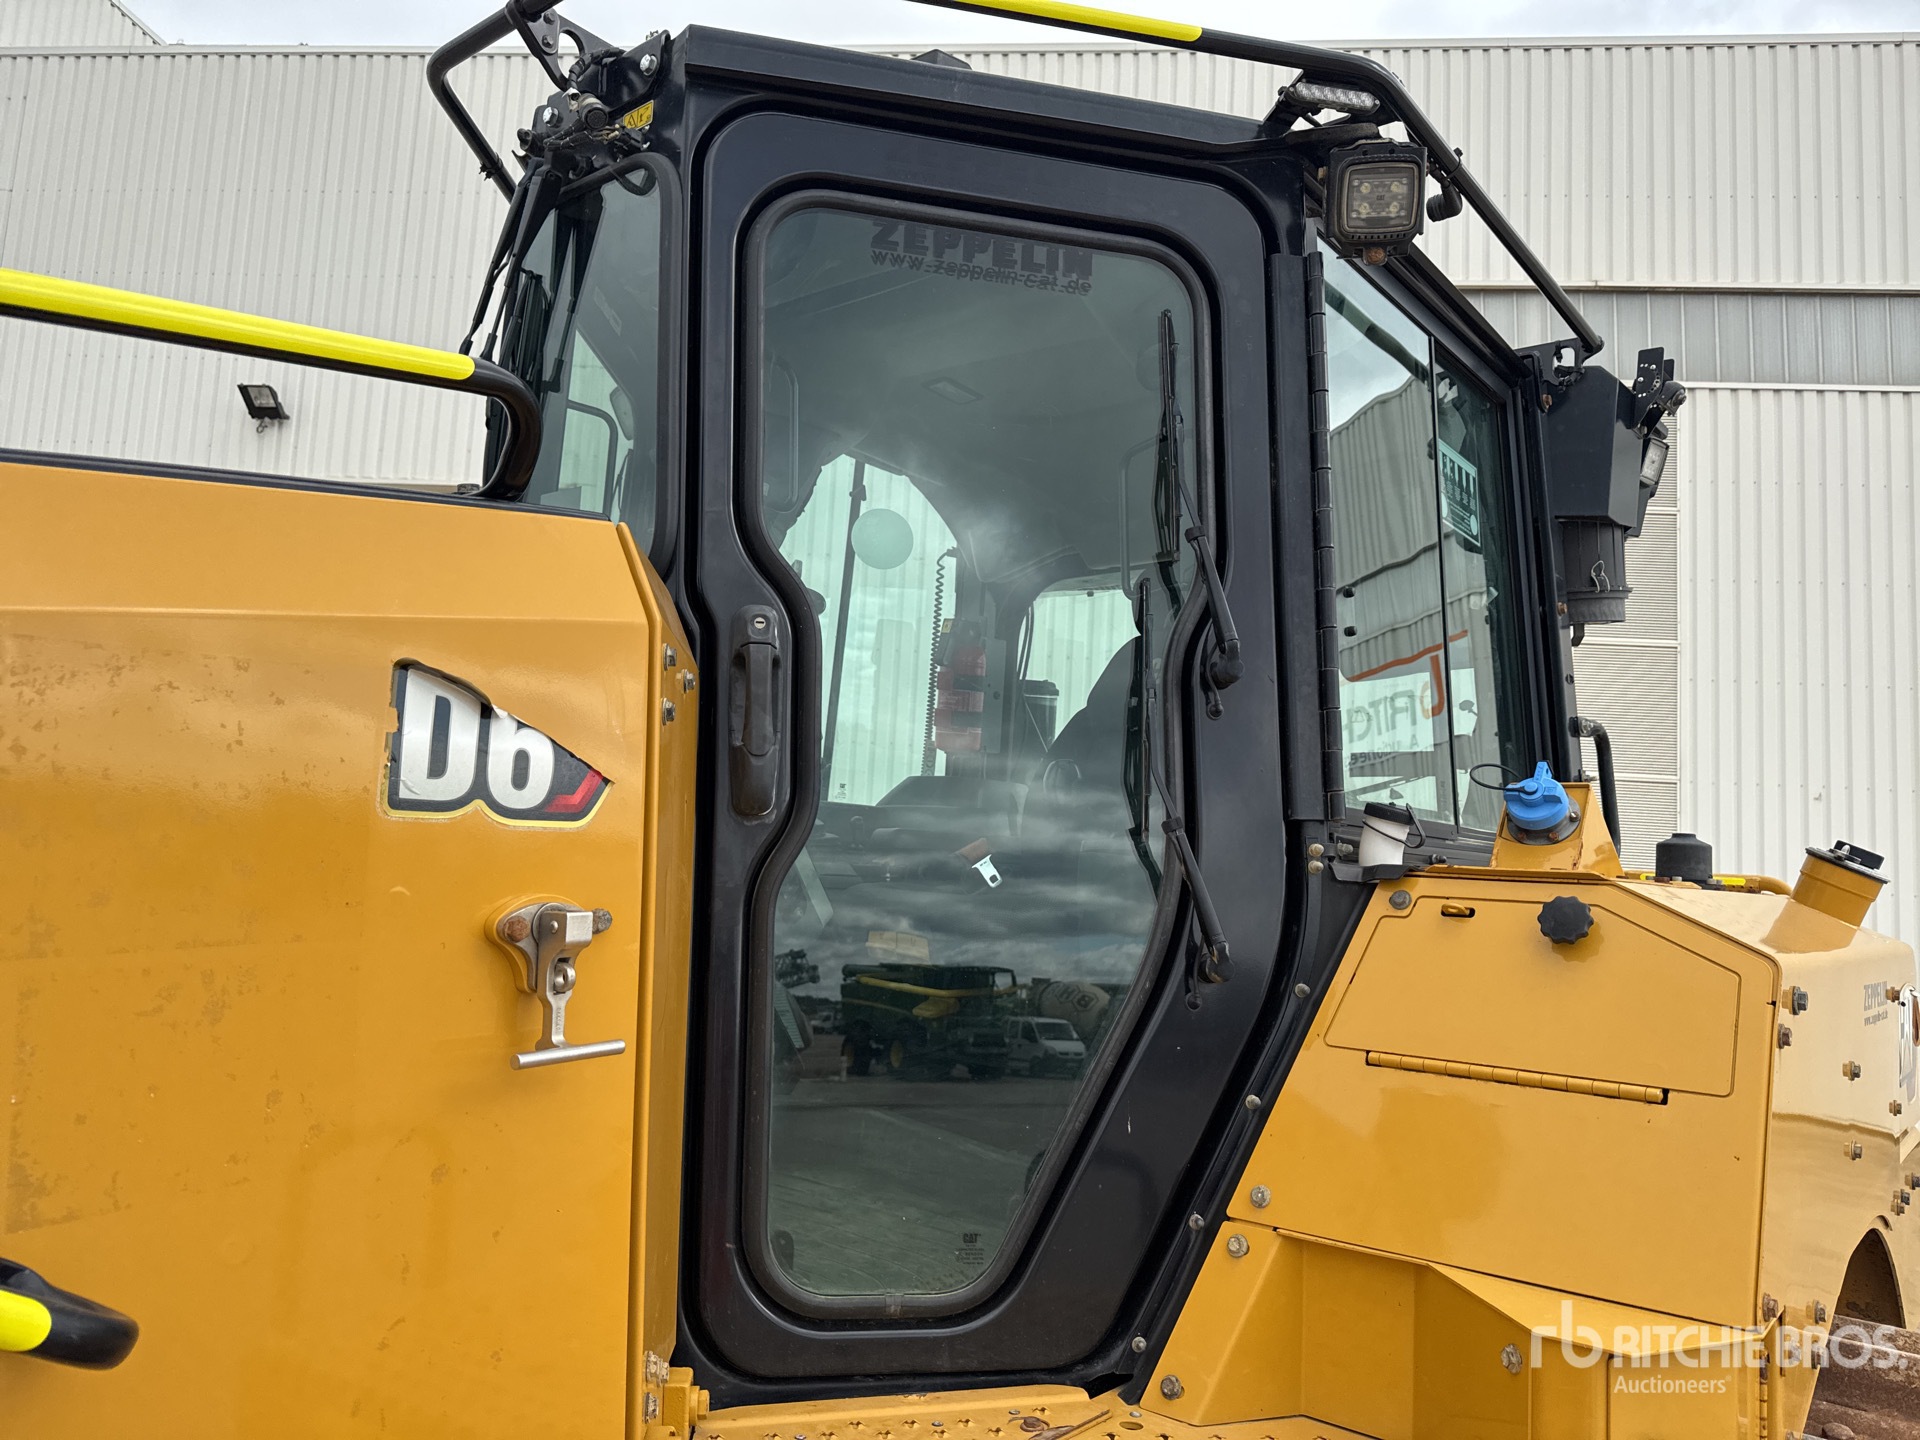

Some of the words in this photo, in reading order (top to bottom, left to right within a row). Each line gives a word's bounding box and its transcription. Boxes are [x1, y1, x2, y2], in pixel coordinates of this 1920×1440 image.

[870, 219, 1094, 280] ZEPPELIN
[398, 668, 555, 810] D6
[963, 1233, 979, 1244] CAT
